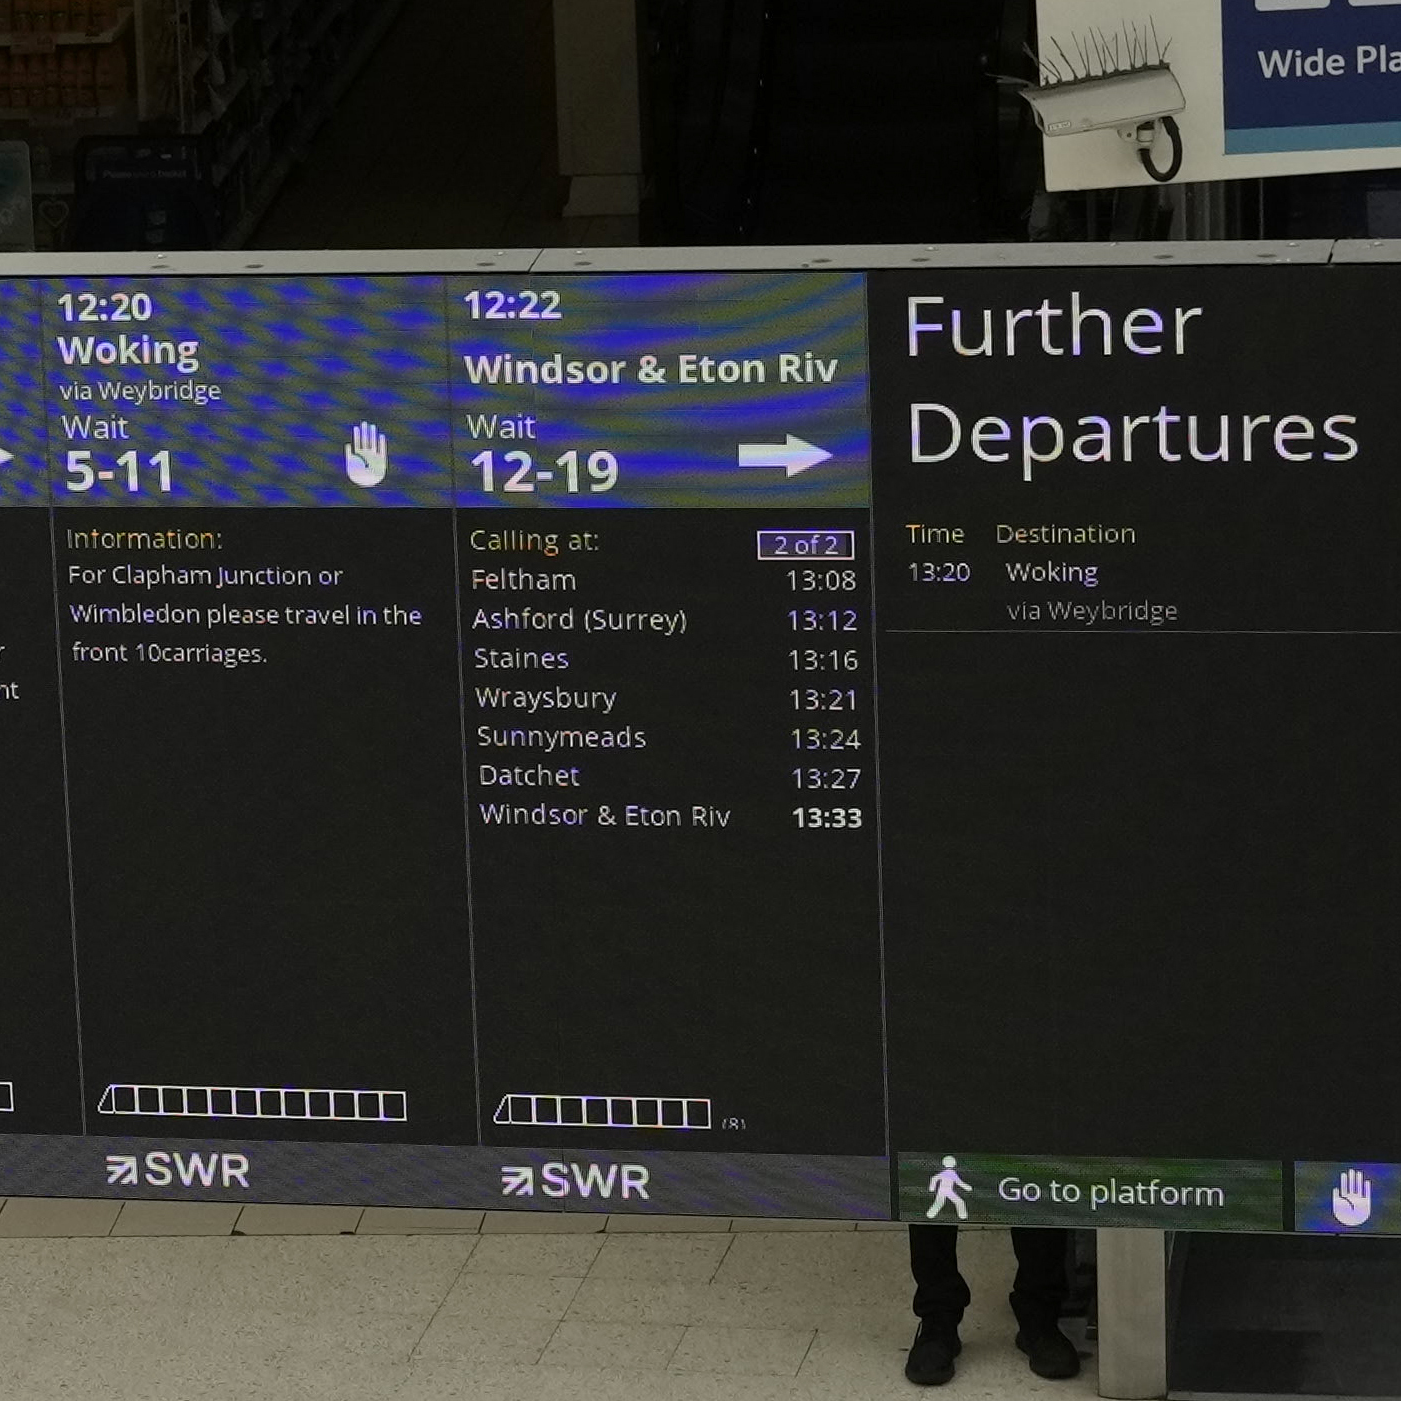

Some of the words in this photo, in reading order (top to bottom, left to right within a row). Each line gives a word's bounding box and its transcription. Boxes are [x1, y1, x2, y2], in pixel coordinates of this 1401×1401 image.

[1257, 47, 1345, 79] Wide
[57, 293, 152, 322] 12:20
[464, 290, 562, 319] 12:22
[908, 291, 1203, 357] Further
[56, 334, 199, 374] Woking
[463, 353, 627, 384] Windsor
[638, 355, 667, 383] &
[679, 354, 765, 383] Eton
[779, 352, 838, 383] Riv
[57, 375, 92, 400] via
[96, 379, 221, 406] Weybridge
[61, 414, 129, 440] Wait
[466, 413, 536, 439] Wait
[910, 403, 1358, 482] Departures
[66, 450, 171, 492] 5-11
[471, 450, 619, 493] 12-19
[905, 524, 965, 544] Time
[996, 524, 1136, 544] Destination
[909, 562, 971, 582] 13:20
[1005, 560, 1099, 588] Woking
[1006, 598, 1041, 620] via
[1048, 599, 1177, 626] Weybridge
[477, 725, 647, 753] Sunnymeads
[792, 728, 862, 750] 13:24
[479, 763, 580, 787] Datchet
[792, 768, 861, 789] 13:27
[479, 802, 589, 825] Windsor
[597, 805, 617, 826] &
[625, 805, 681, 827] Eton
[692, 805, 731, 828] Riv
[792, 807, 862, 829] 13:33
[145, 1151, 249, 1188] SWR
[541, 1162, 650, 1200] SWR
[998, 1177, 1042, 1202] Go
[1049, 1180, 1081, 1203] to
[1091, 1178, 1224, 1211] platform
